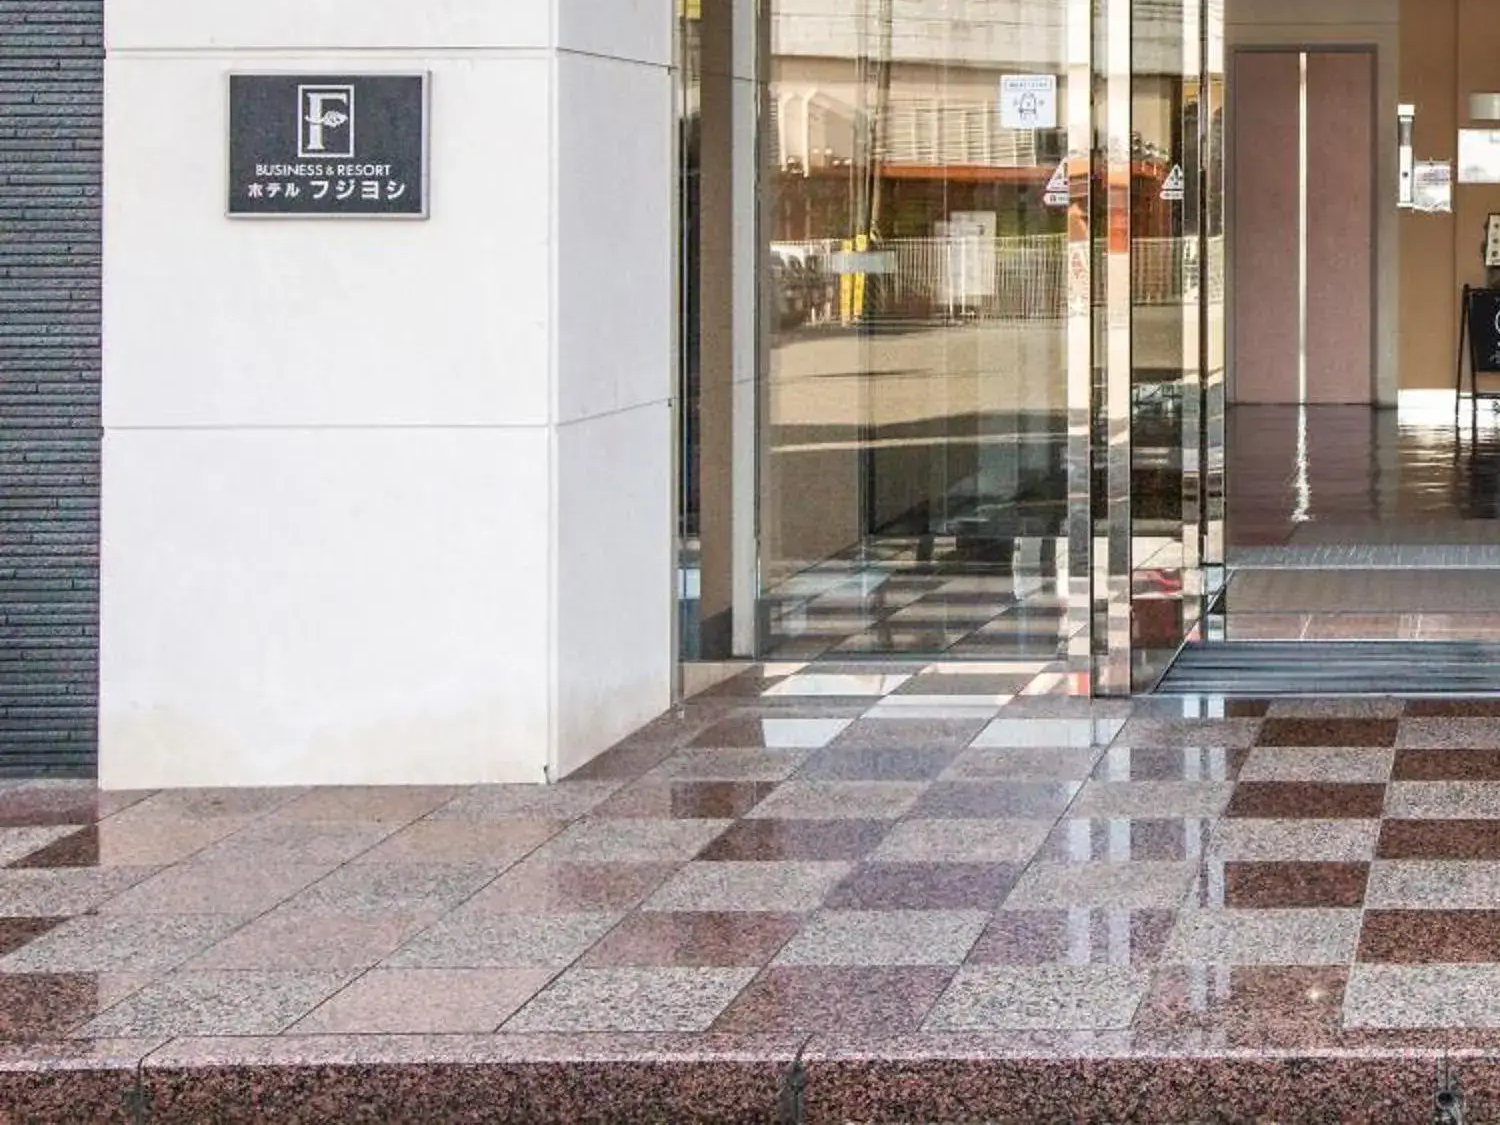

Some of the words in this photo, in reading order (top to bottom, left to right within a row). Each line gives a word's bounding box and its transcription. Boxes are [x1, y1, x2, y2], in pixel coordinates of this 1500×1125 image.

[254, 163, 323, 177] BUSINESS
[336, 163, 392, 177] RESORT
[247, 181, 301, 199] ホテル
[308, 177, 406, 201] フジヨシ
